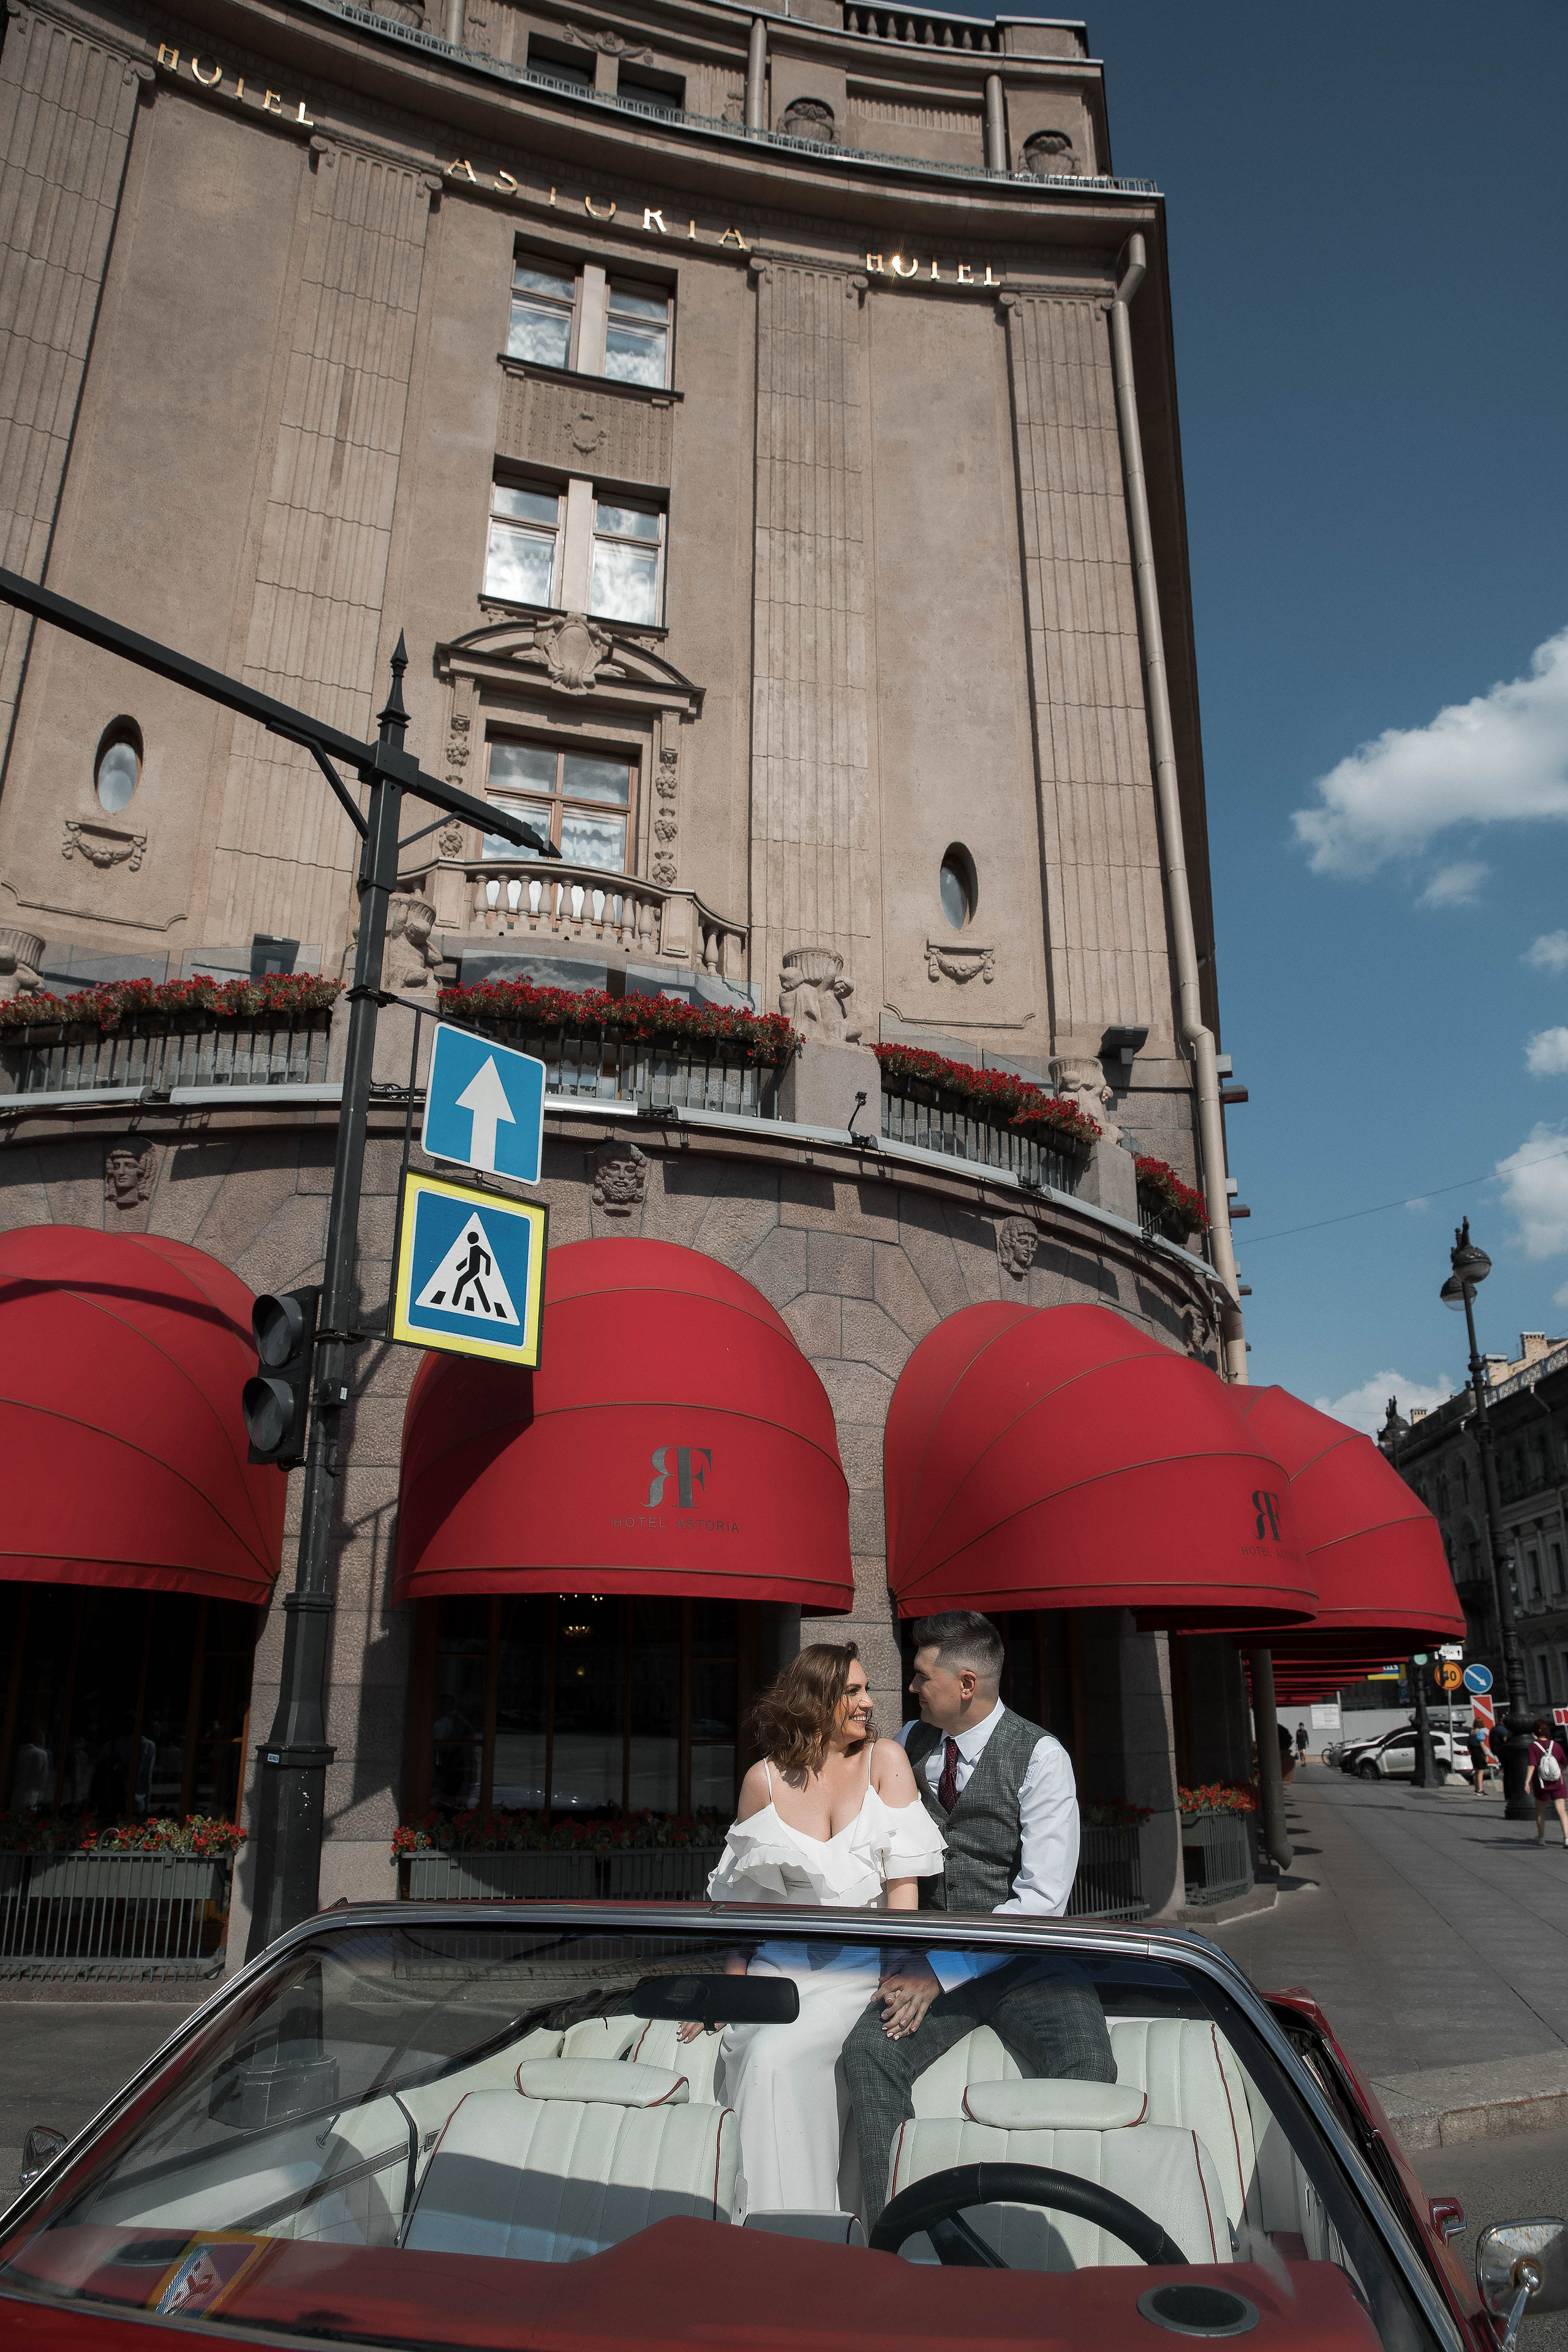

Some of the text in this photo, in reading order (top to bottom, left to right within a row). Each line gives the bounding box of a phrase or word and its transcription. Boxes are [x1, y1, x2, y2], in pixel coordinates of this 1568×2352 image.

[157, 42, 314, 127] HOTEL
[444, 156, 749, 251] ASTORIA
[866, 252, 1001, 286] HOTEL
[613, 1517, 739, 1533] HOTEL ASTORIA
[1241, 1546, 1272, 1557] HOTEL
